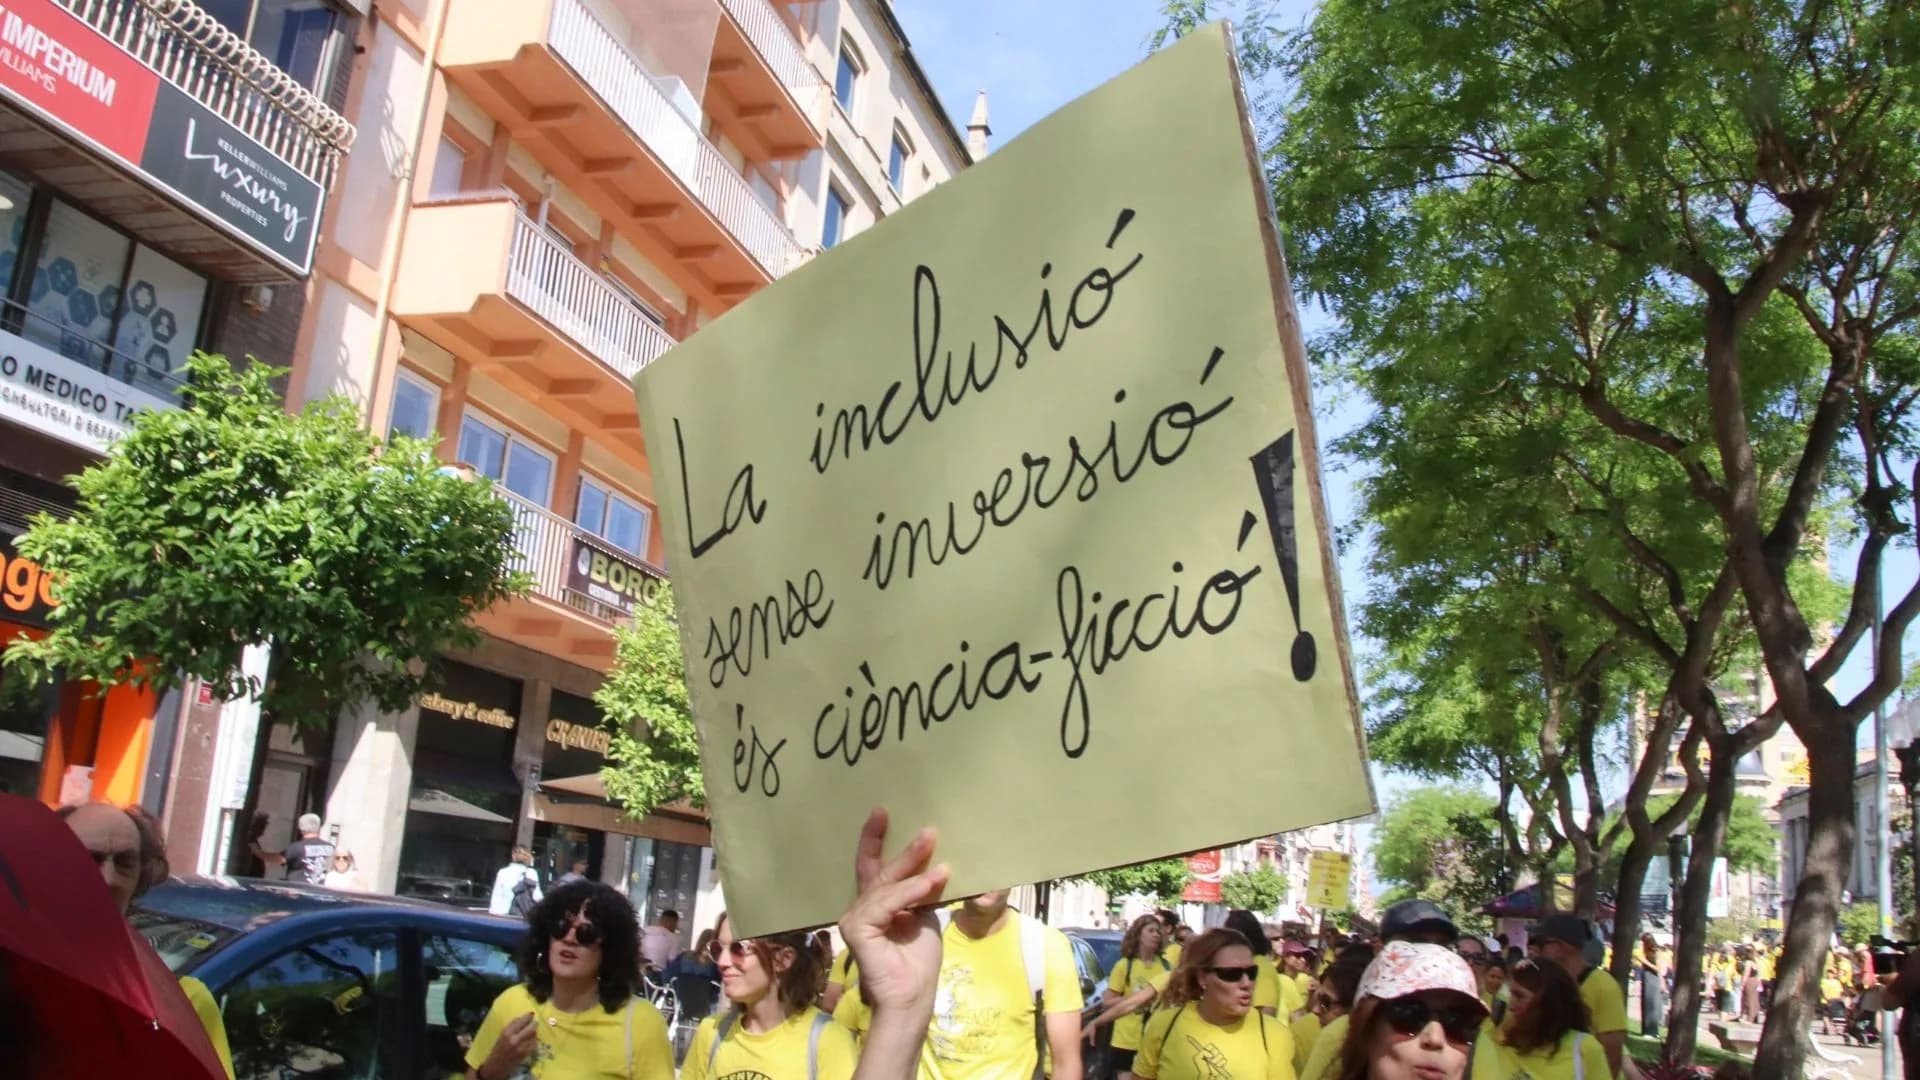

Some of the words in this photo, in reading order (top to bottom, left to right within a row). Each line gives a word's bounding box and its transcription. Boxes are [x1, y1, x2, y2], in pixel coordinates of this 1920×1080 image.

[2, 10, 116, 107] IMPERIUM
[184, 117, 308, 243] Luxury
[220, 190, 268, 228] PROPERTIES
[25, 365, 107, 413] MEDICO
[673, 418, 767, 559] La
[810, 208, 1144, 475] inclusió
[703, 569, 835, 689] sense
[863, 346, 1234, 590] inversió
[733, 704, 787, 798] és
